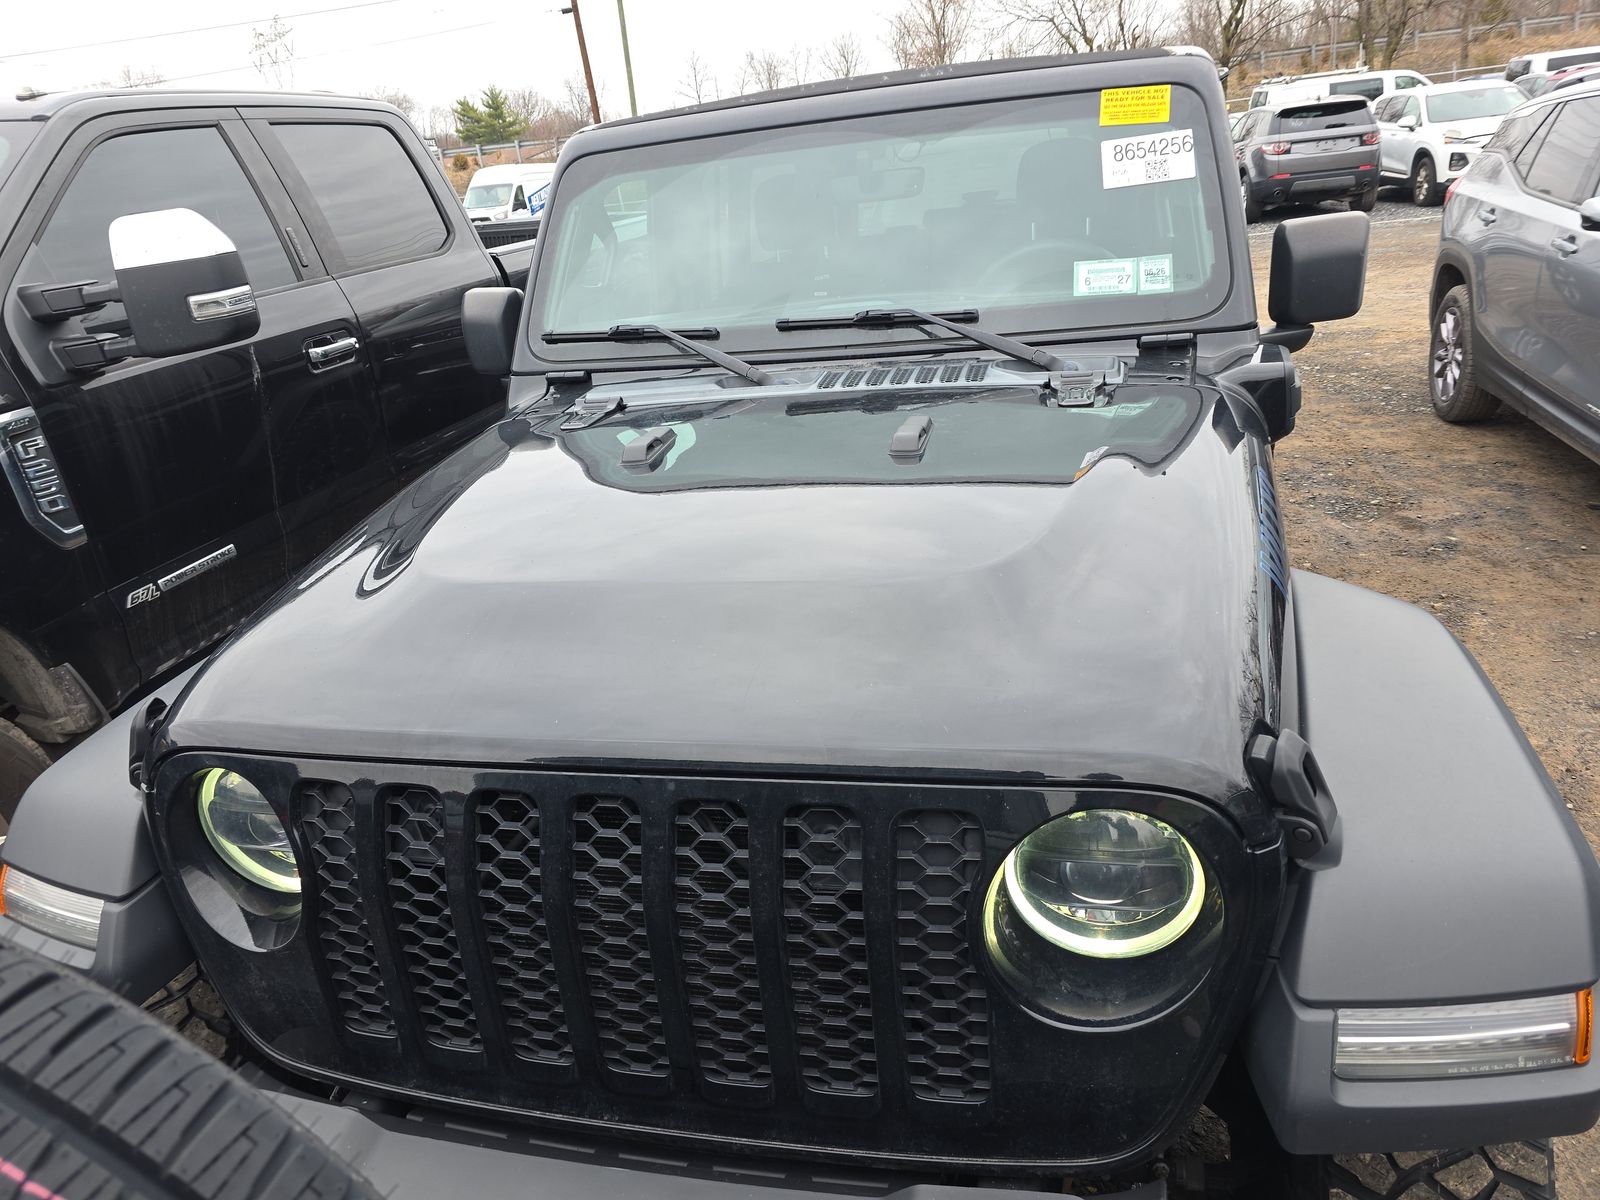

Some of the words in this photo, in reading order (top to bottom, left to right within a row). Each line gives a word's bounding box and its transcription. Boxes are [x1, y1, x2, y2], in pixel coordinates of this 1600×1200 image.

[1122, 88, 1150, 96] VEHICLE
[1113, 134, 1193, 162] 8654256
[1084, 277, 1091, 286] 6
[1117, 274, 1131, 284] 27
[162, 565, 198, 588] POWER
[198, 546, 234, 570] STROKE
